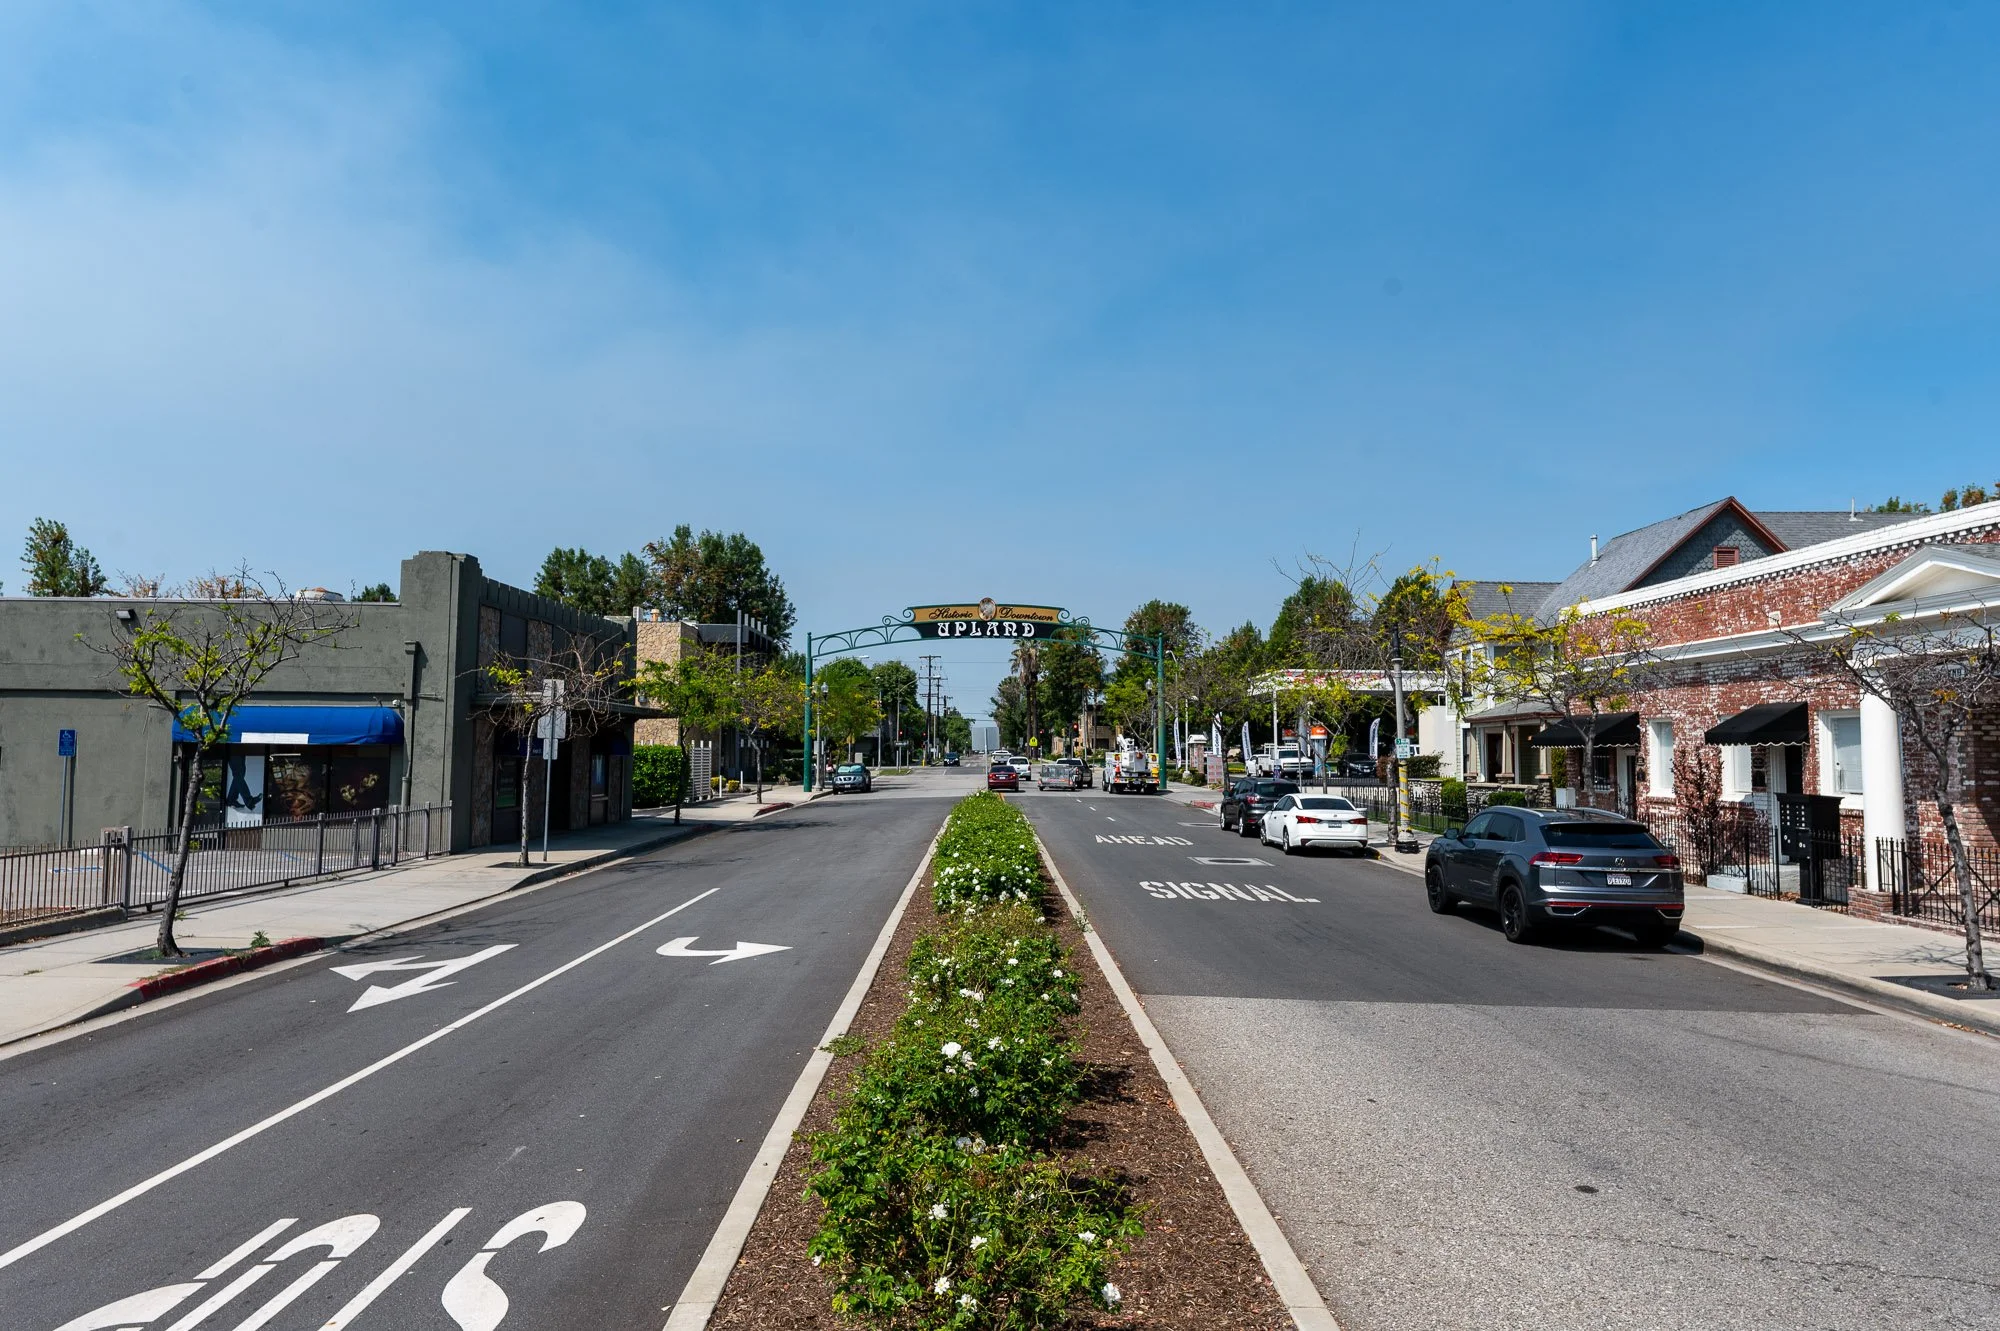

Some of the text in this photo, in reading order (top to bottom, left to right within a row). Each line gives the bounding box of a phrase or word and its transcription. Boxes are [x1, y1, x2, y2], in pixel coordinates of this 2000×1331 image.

[929, 606, 1054, 622] Historic Downtown
[937, 621, 1035, 637] UPLAND
[1095, 834, 1194, 846] AHEAD
[1138, 880, 1321, 904] SIGNAL
